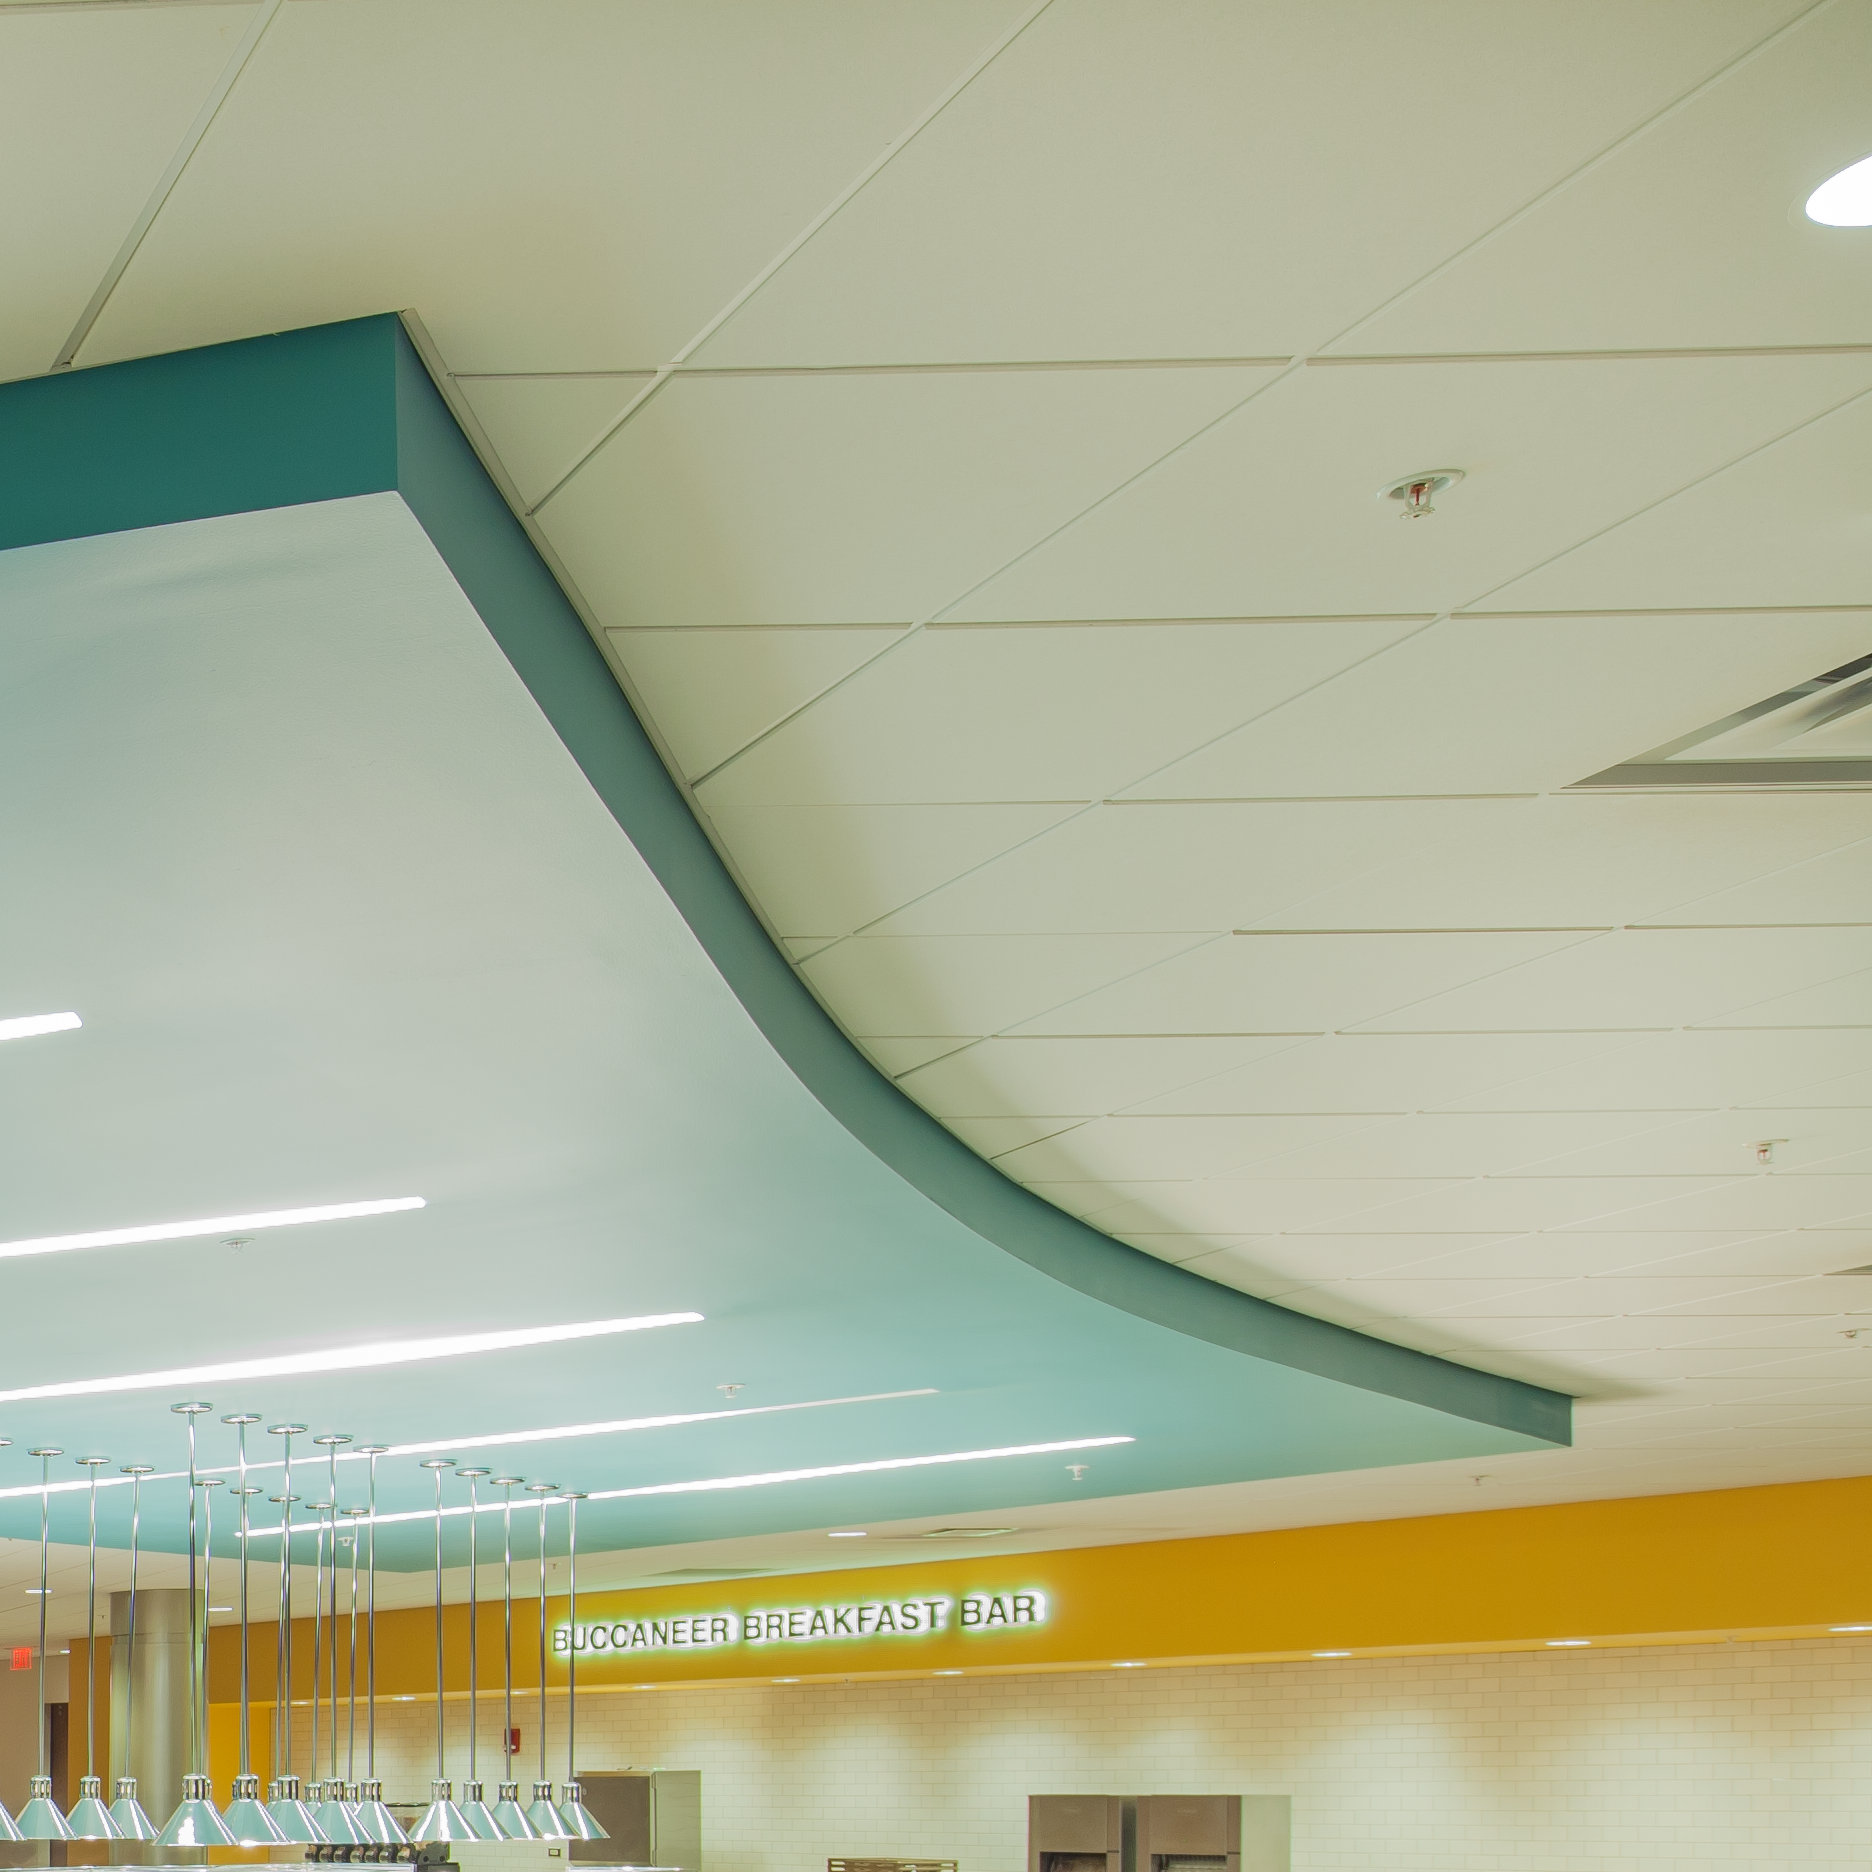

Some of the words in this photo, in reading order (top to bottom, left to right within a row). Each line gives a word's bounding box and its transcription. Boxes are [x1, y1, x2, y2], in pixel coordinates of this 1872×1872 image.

[553, 1617, 729, 1652] BUCCANEER
[743, 1601, 945, 1640] BREAKFAST
[960, 1594, 1036, 1627] BAR
